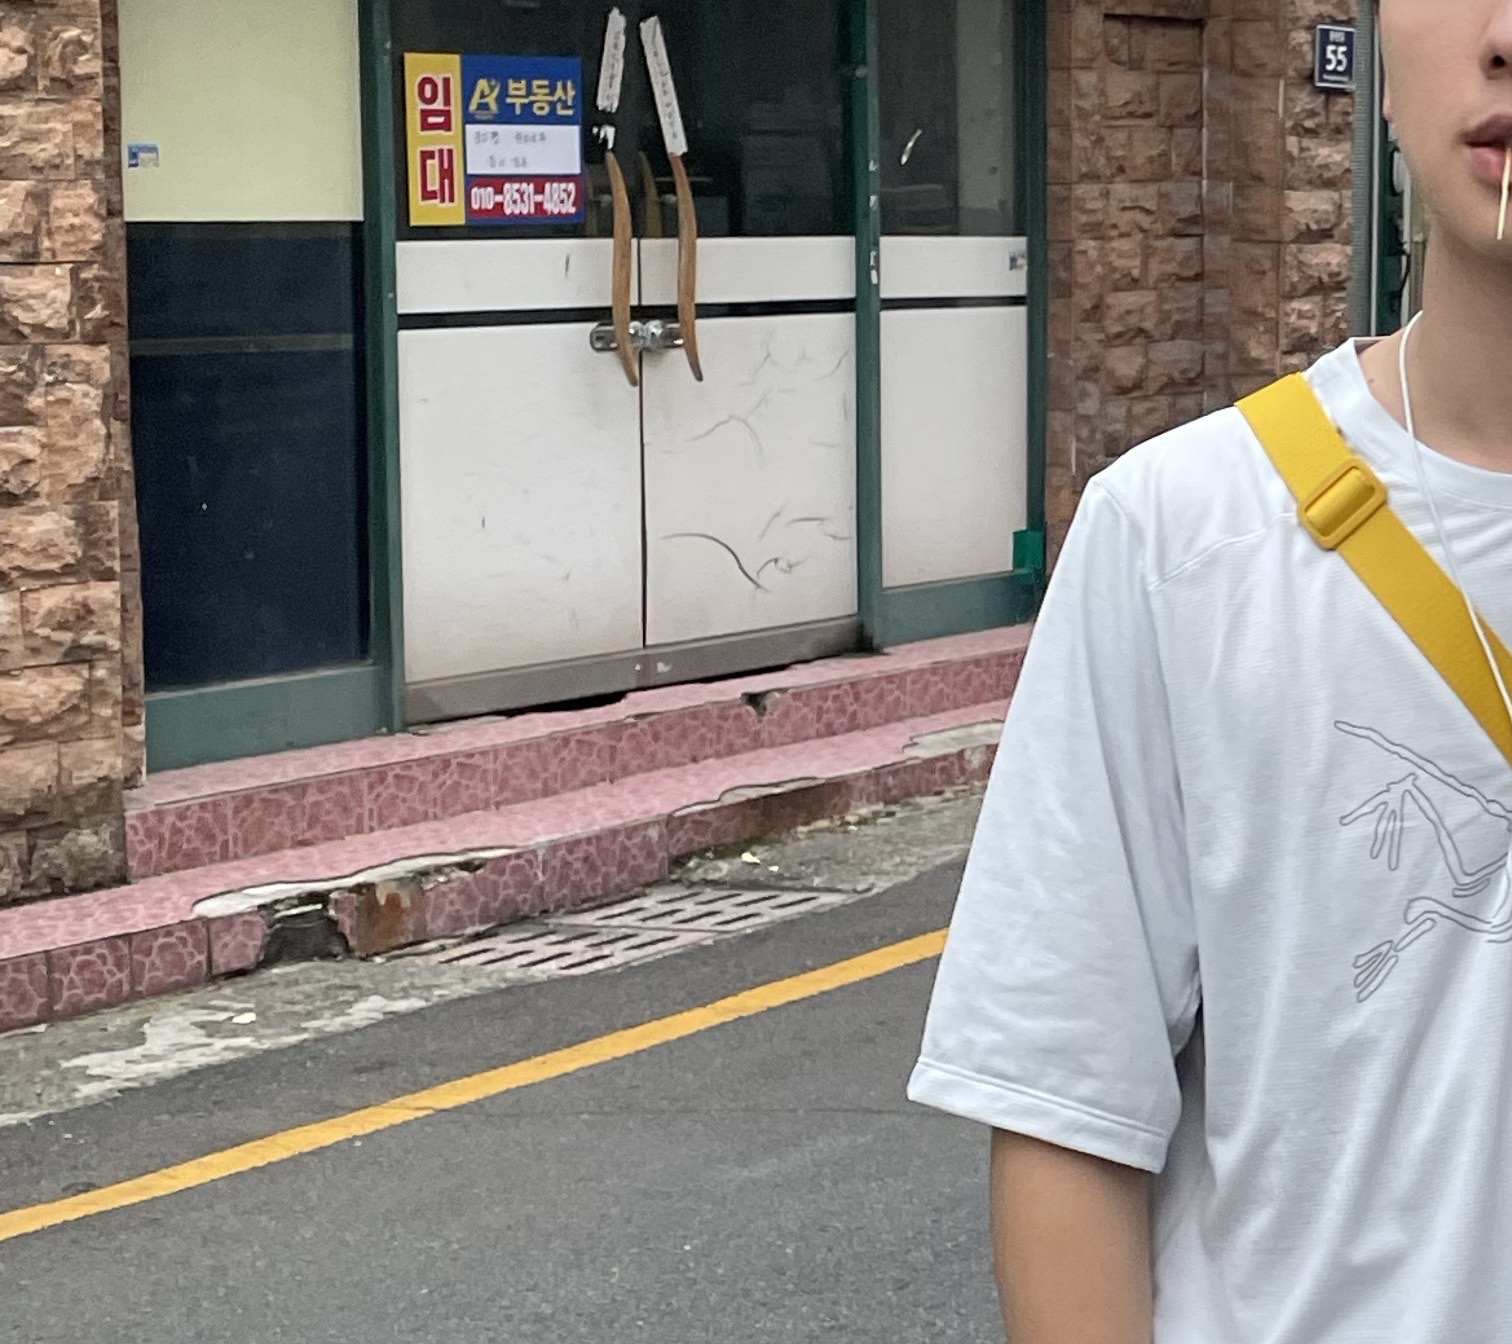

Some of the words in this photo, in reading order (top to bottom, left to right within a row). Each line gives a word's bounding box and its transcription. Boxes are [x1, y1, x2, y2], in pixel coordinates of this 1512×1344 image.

[1325, 44, 1348, 72] 55
[505, 78, 576, 116] 부동산
[417, 75, 456, 204] 임대
[471, 182, 577, 216] 010-8531-4852
